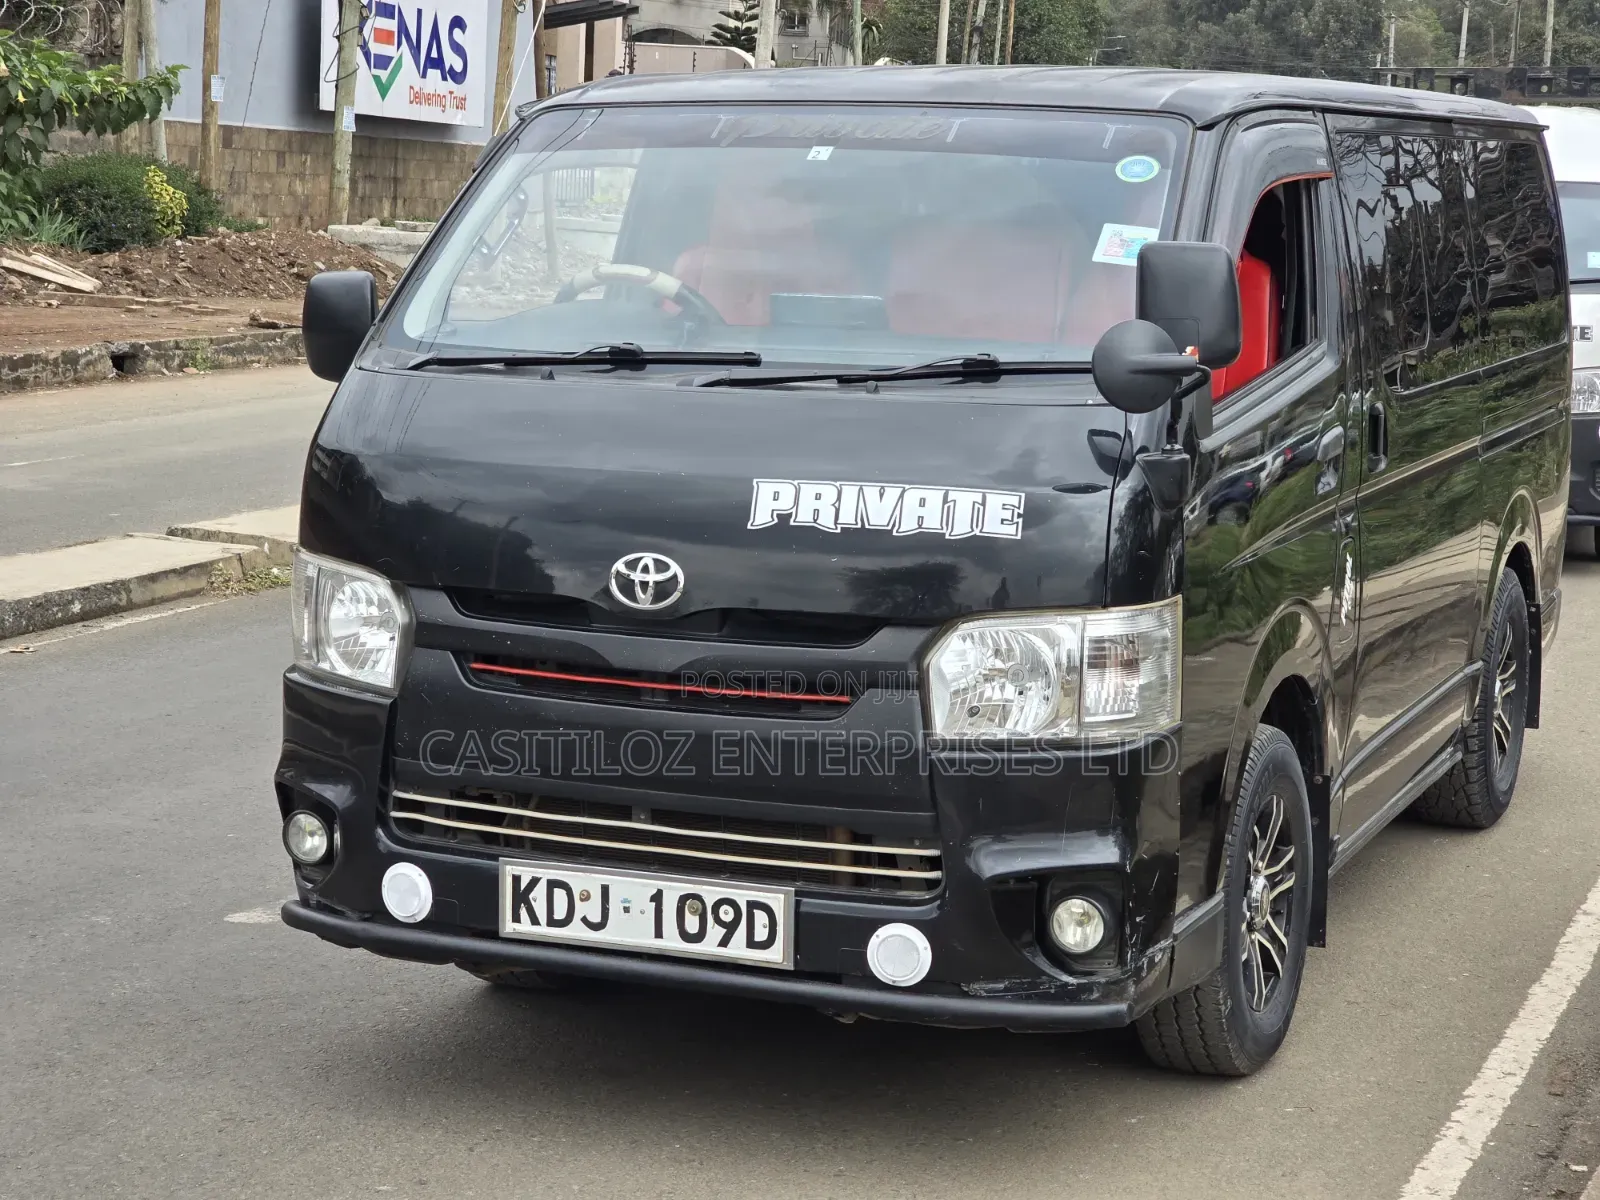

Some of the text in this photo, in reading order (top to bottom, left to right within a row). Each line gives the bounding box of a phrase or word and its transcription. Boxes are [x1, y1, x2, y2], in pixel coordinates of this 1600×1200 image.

[409, 84, 467, 113] Delivering Trust
[747, 479, 1025, 539] PRIVATE
[511, 874, 778, 951] KDJ 109D
